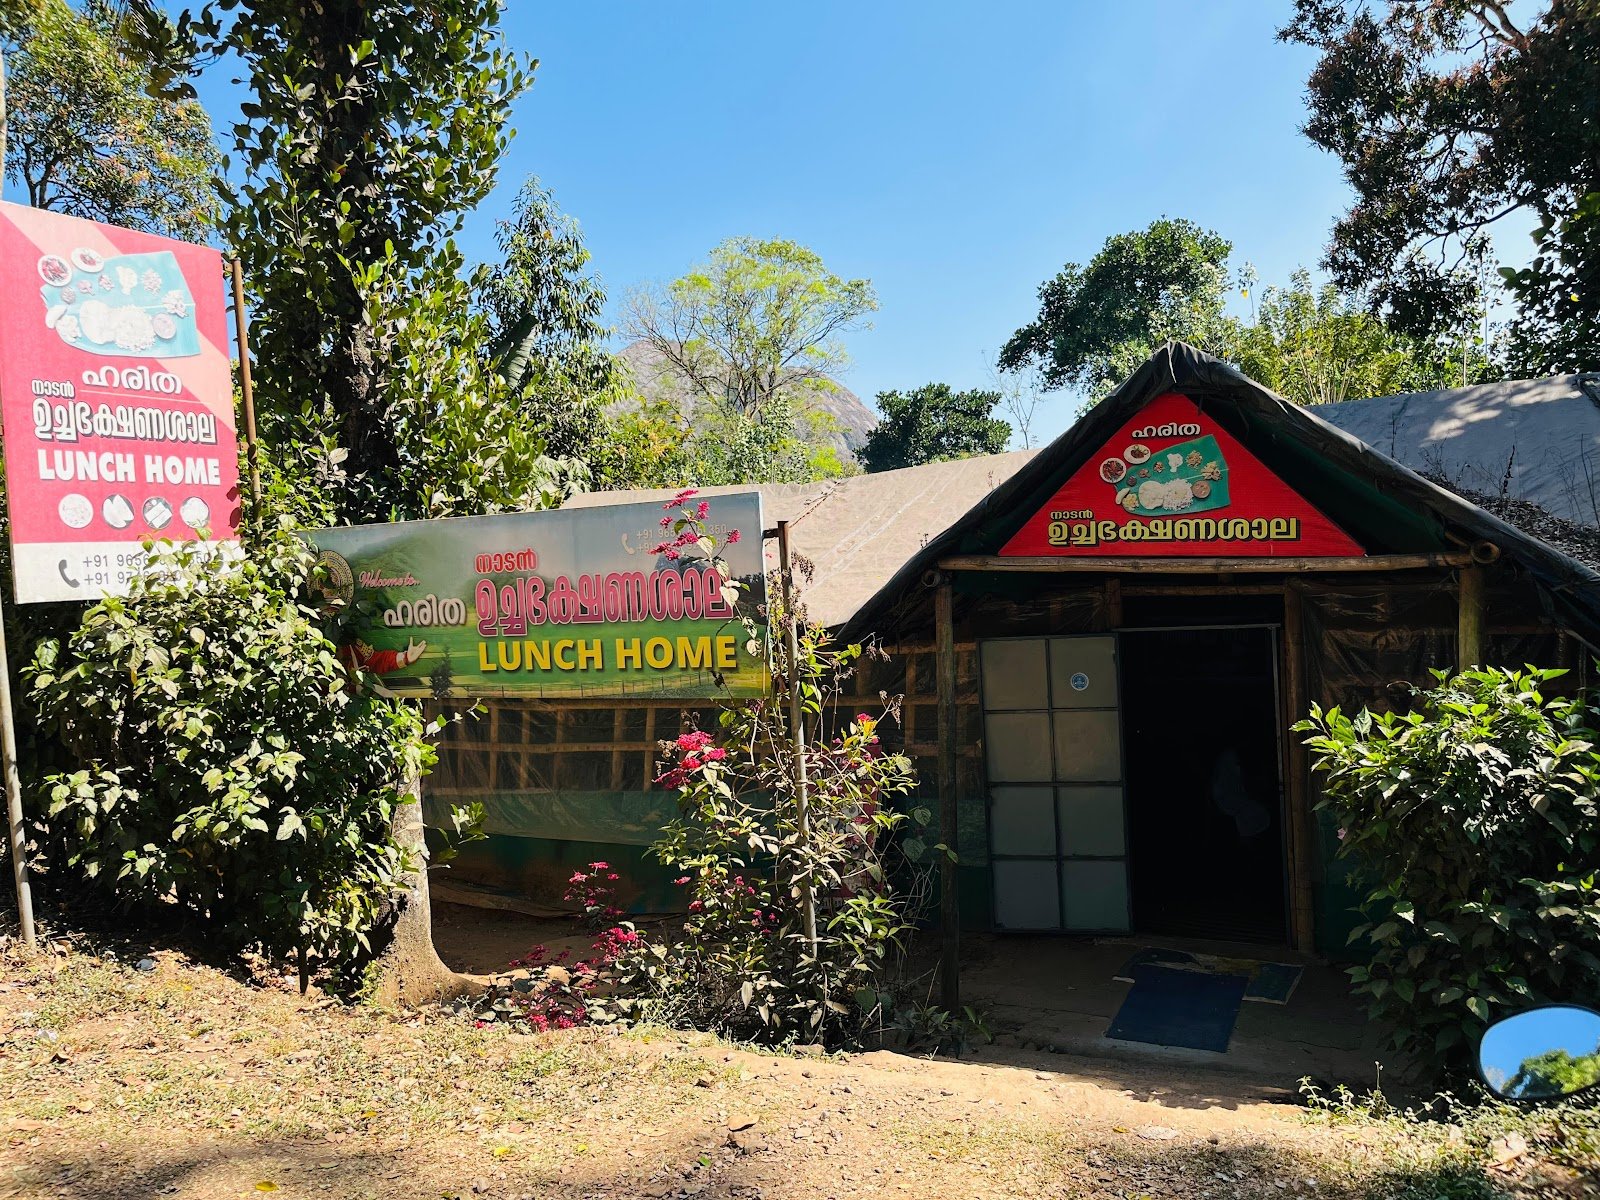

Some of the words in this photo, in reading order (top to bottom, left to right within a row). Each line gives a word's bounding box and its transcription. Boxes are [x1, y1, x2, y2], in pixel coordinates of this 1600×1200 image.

[82, 365, 182, 394] ഹരിത
[32, 397, 217, 444] ഉച്ചഭക്ഷണശാല
[1131, 422, 1201, 438] ഹരിത
[37, 449, 136, 482] LUNCH
[144, 454, 221, 486] HOME
[637, 529, 653, 540] +91
[658, 528, 683, 538] 965
[1048, 517, 1298, 546] ഉച്ചഭക്ഷണശാല
[83, 554, 109, 568] +91
[84, 571, 110, 586] +91
[383, 593, 467, 627] ഹരിത
[479, 638, 603, 672] LUNCH
[616, 636, 738, 670] HOME
